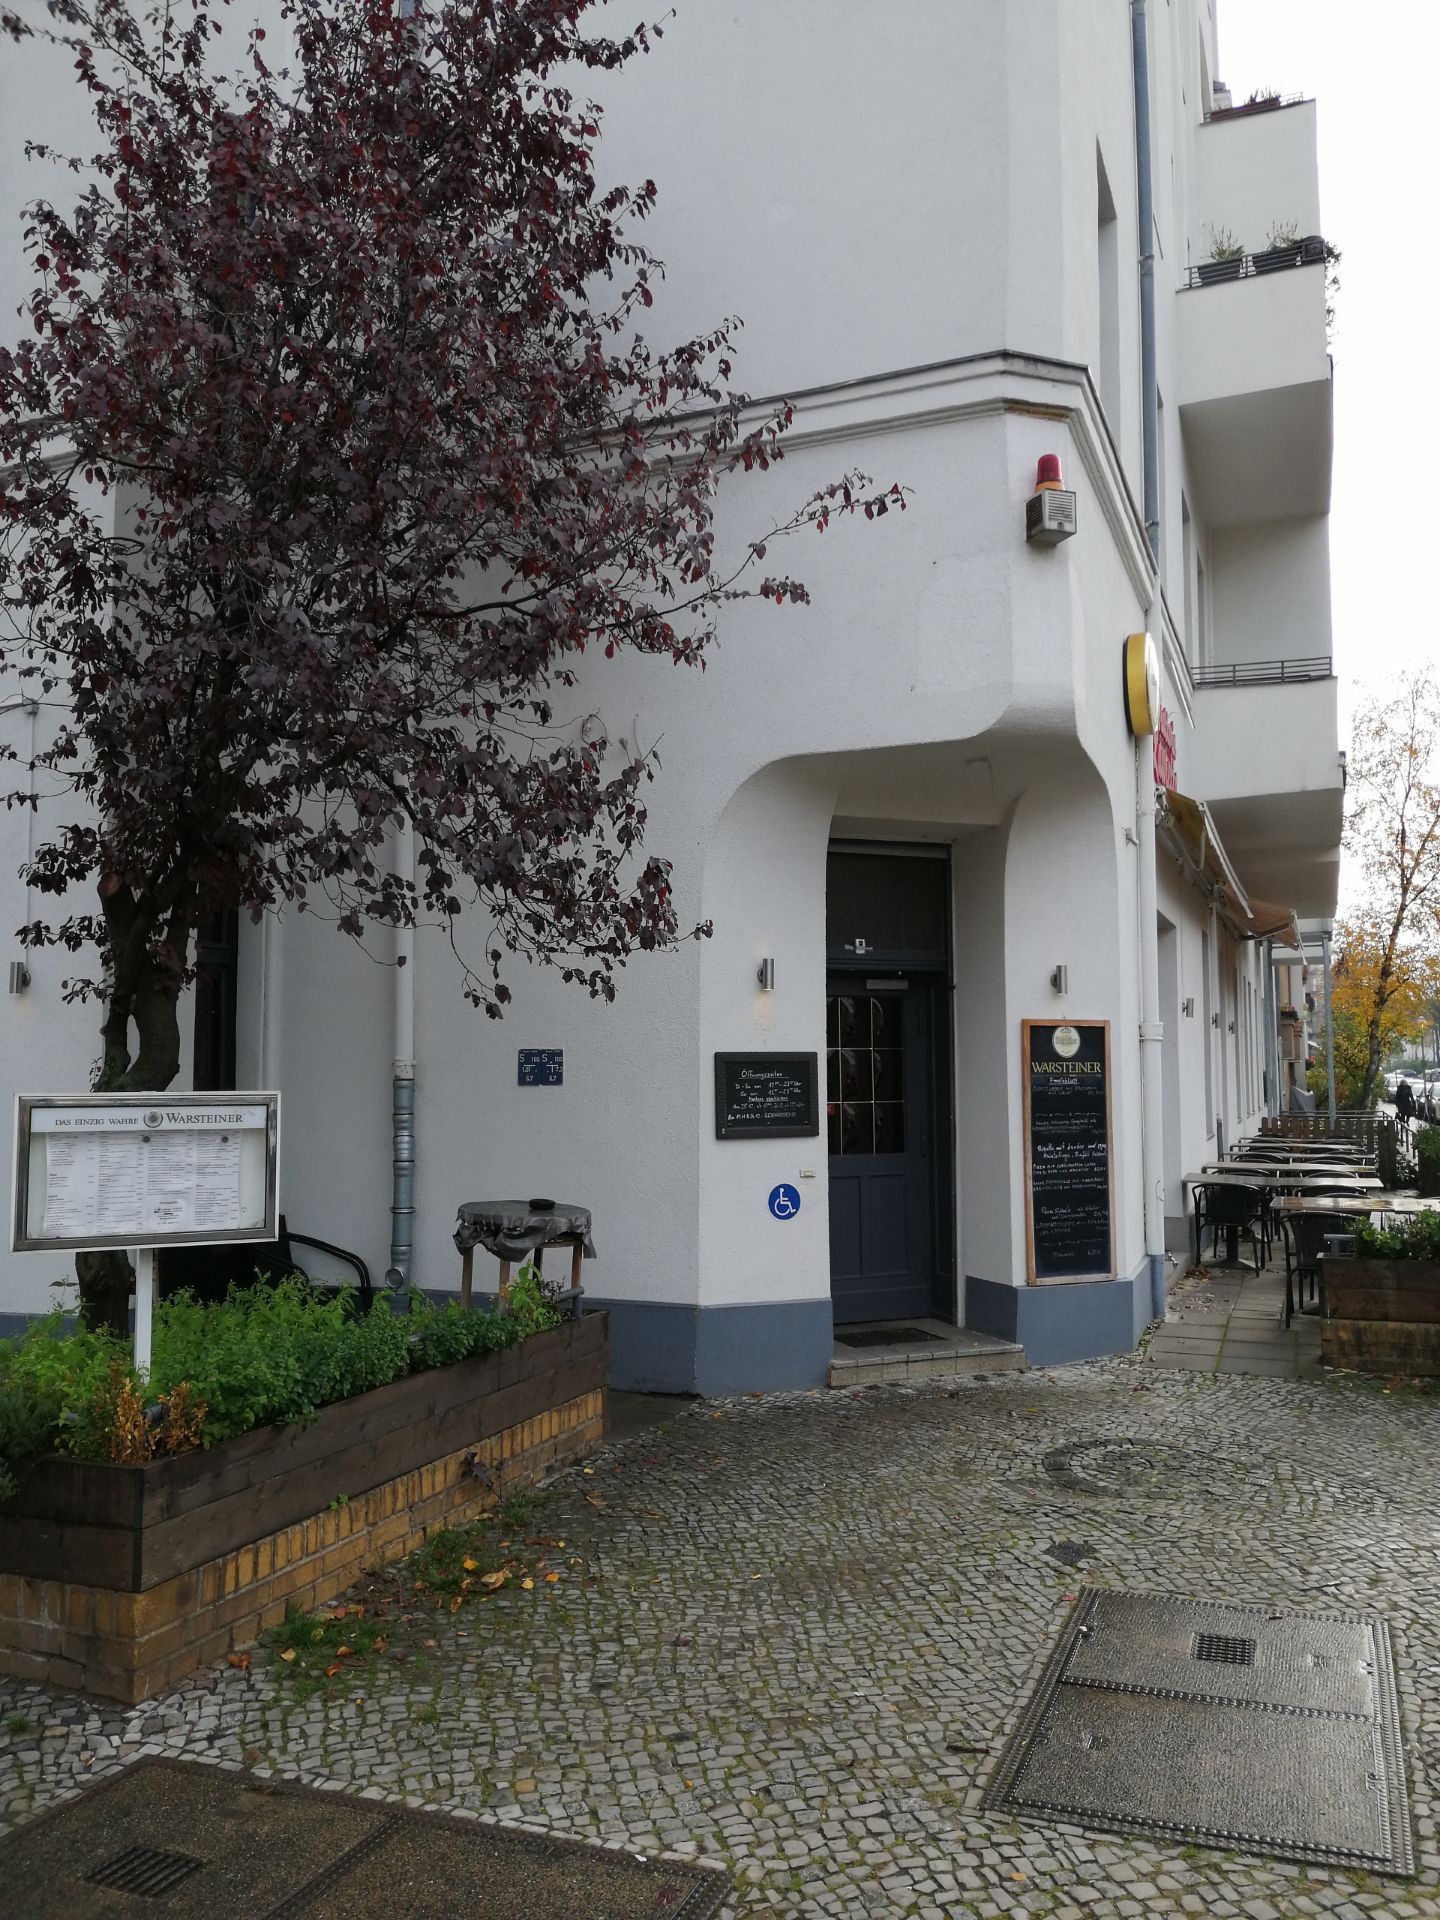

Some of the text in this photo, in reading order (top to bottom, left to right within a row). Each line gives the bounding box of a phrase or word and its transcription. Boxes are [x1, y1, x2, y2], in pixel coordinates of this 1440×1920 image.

[520, 1054, 525, 1062] S
[542, 1054, 547, 1062] S
[1031, 1061, 1102, 1073] WARSTEINER
[55, 1111, 243, 1126] DAS EINZIG WAHRE WARSTEINER
